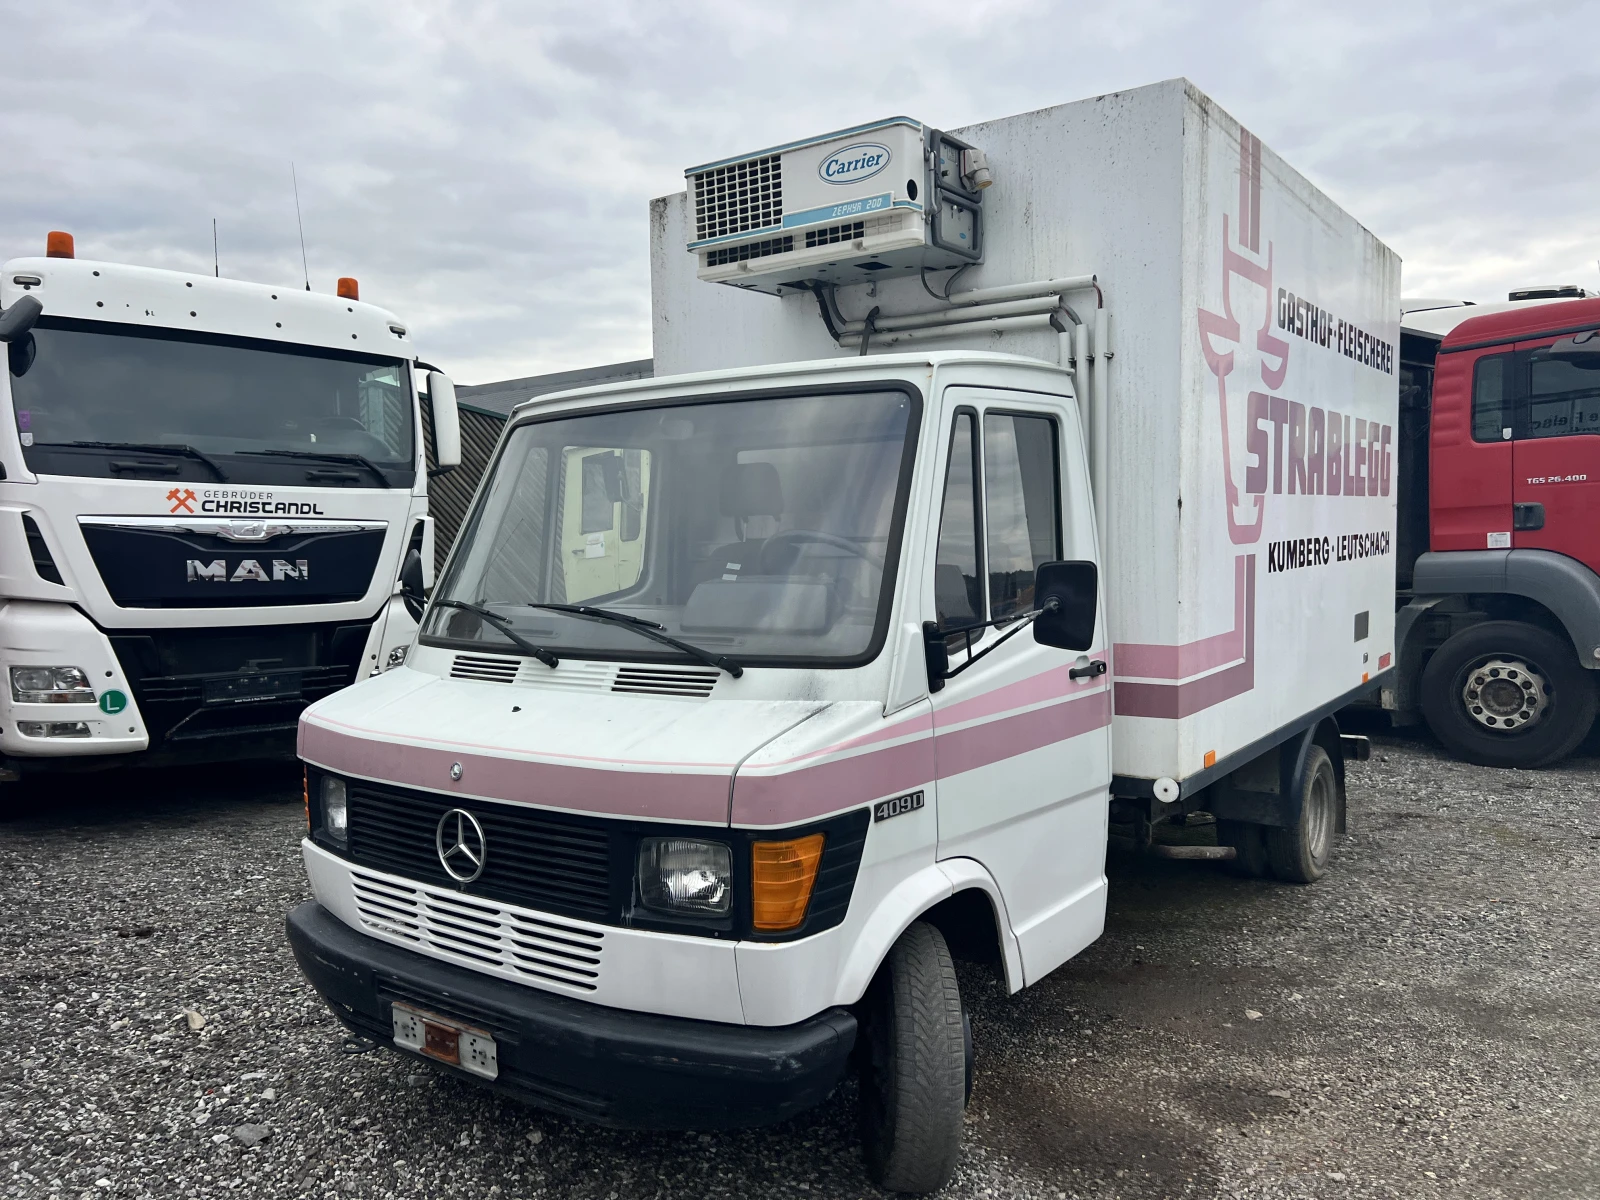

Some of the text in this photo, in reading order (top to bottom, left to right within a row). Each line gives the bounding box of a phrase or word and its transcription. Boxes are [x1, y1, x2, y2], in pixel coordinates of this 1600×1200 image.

[825, 152, 883, 177] Carrier
[832, 197, 882, 217] ZEPHYR 200
[1245, 391, 1391, 497] STRABLEGG
[1547, 474, 1587, 483] 26.400
[203, 490, 273, 500] GEBRÜDER
[201, 500, 324, 515] CHRISTANDL
[1268, 531, 1390, 573] KUMBERG LEUTSCHACH
[186, 559, 309, 582] MAN
[106, 694, 120, 711] L
[877, 792, 924, 818] 409D
